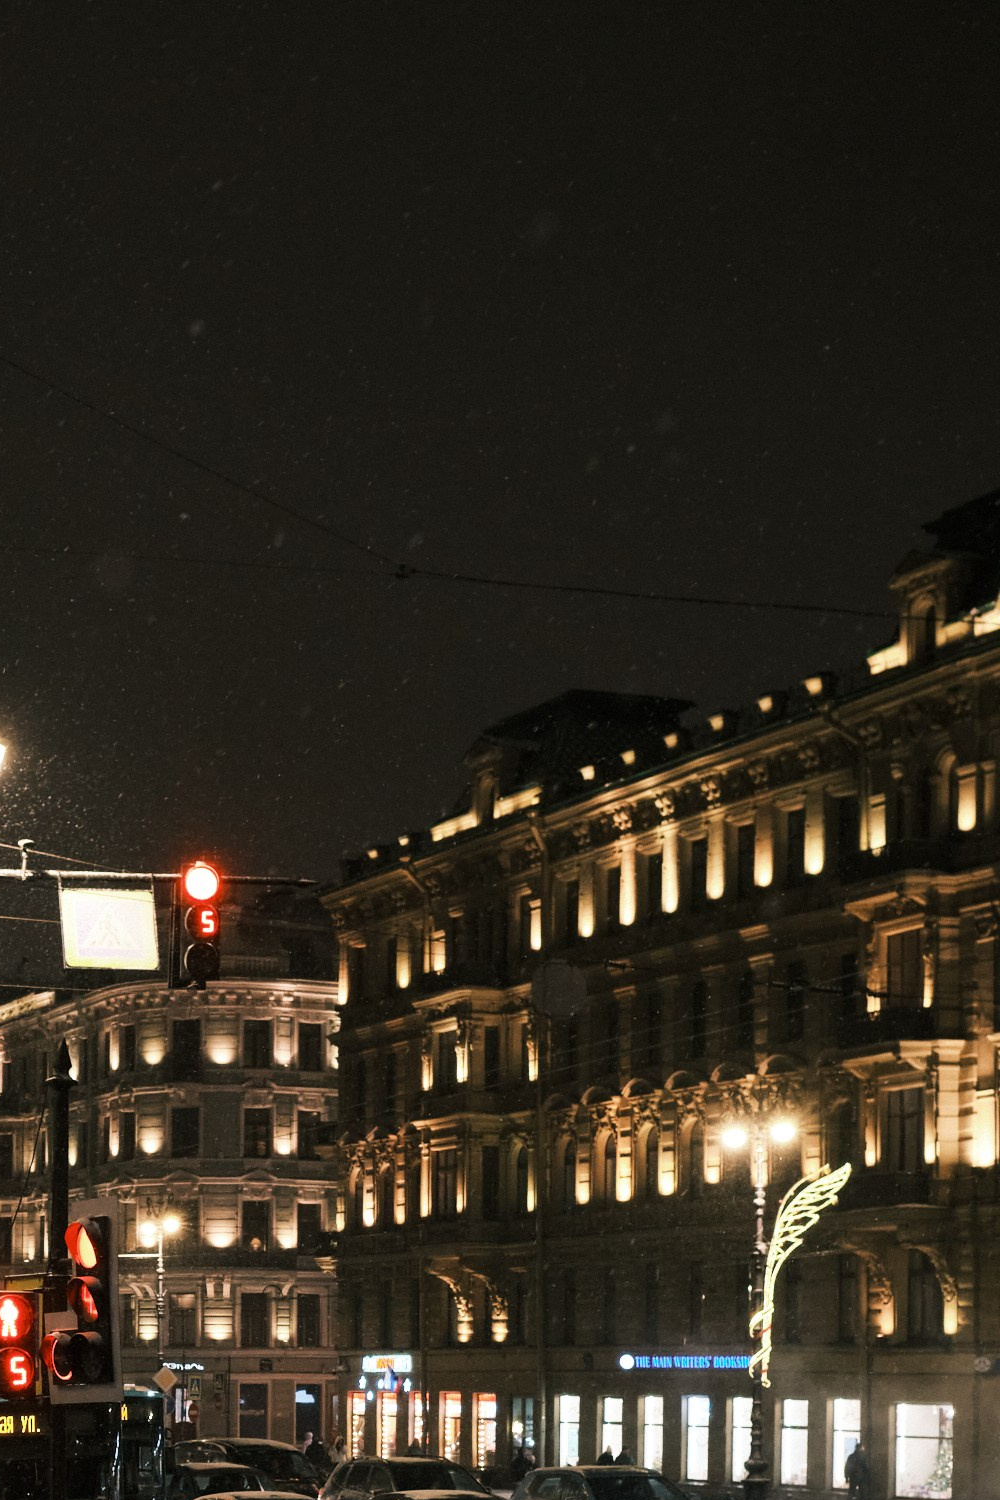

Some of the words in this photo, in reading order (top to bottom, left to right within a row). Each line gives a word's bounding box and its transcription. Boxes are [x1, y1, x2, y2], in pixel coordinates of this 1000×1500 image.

[201, 910, 215, 933] 5
[10, 1356, 27, 1385] 5
[635, 1356, 650, 1368] THE
[652, 1356, 672, 1368] MAIN
[20, 1415, 41, 1433] ул.
